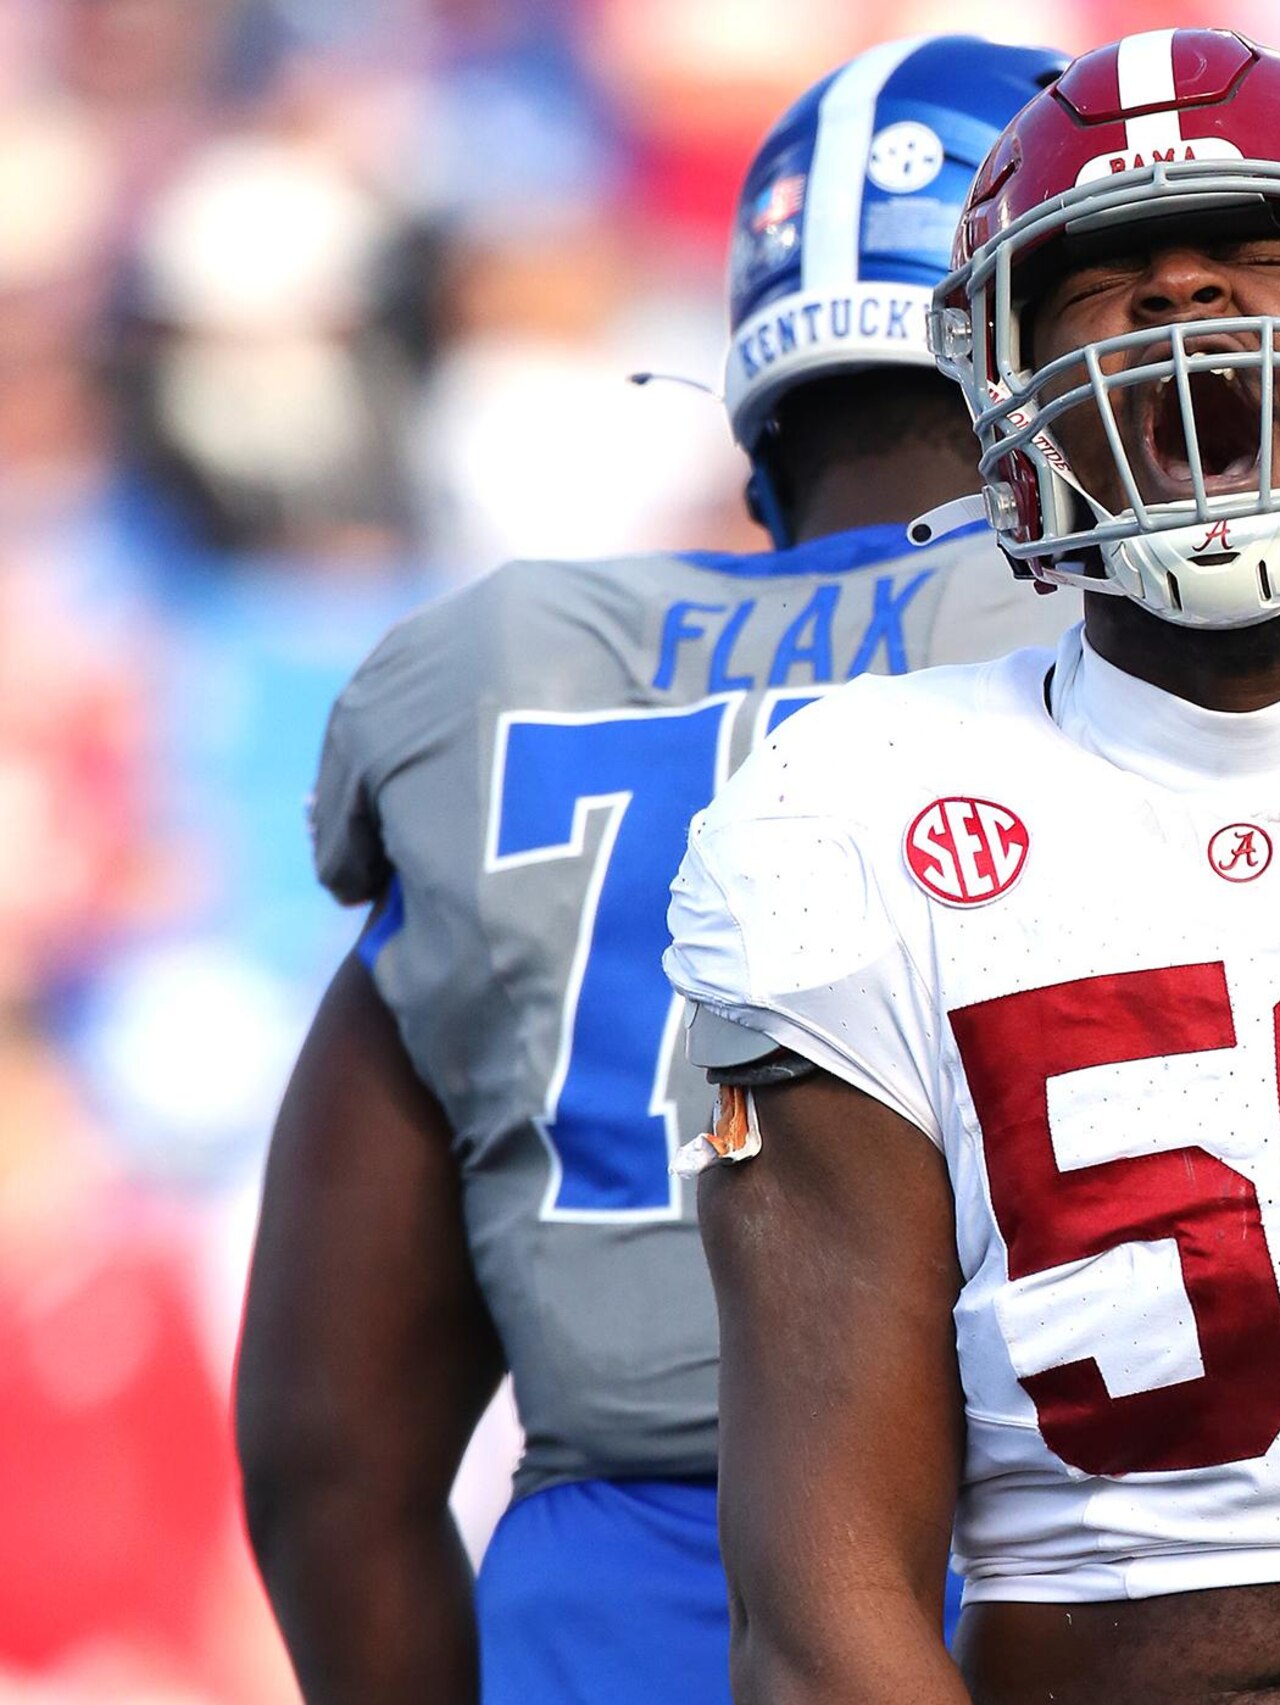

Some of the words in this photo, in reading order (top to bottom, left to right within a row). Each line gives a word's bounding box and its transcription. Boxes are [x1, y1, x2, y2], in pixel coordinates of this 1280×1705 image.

[1110, 146, 1196, 174] BAMA
[739, 298, 932, 379] KENTUCK
[1034, 435, 1072, 472] TIDE
[1192, 517, 1234, 552] A
[652, 567, 935, 694] FLAX
[911, 800, 1025, 899] SEC
[1218, 830, 1259, 871] A
[485, 684, 848, 1222] 7
